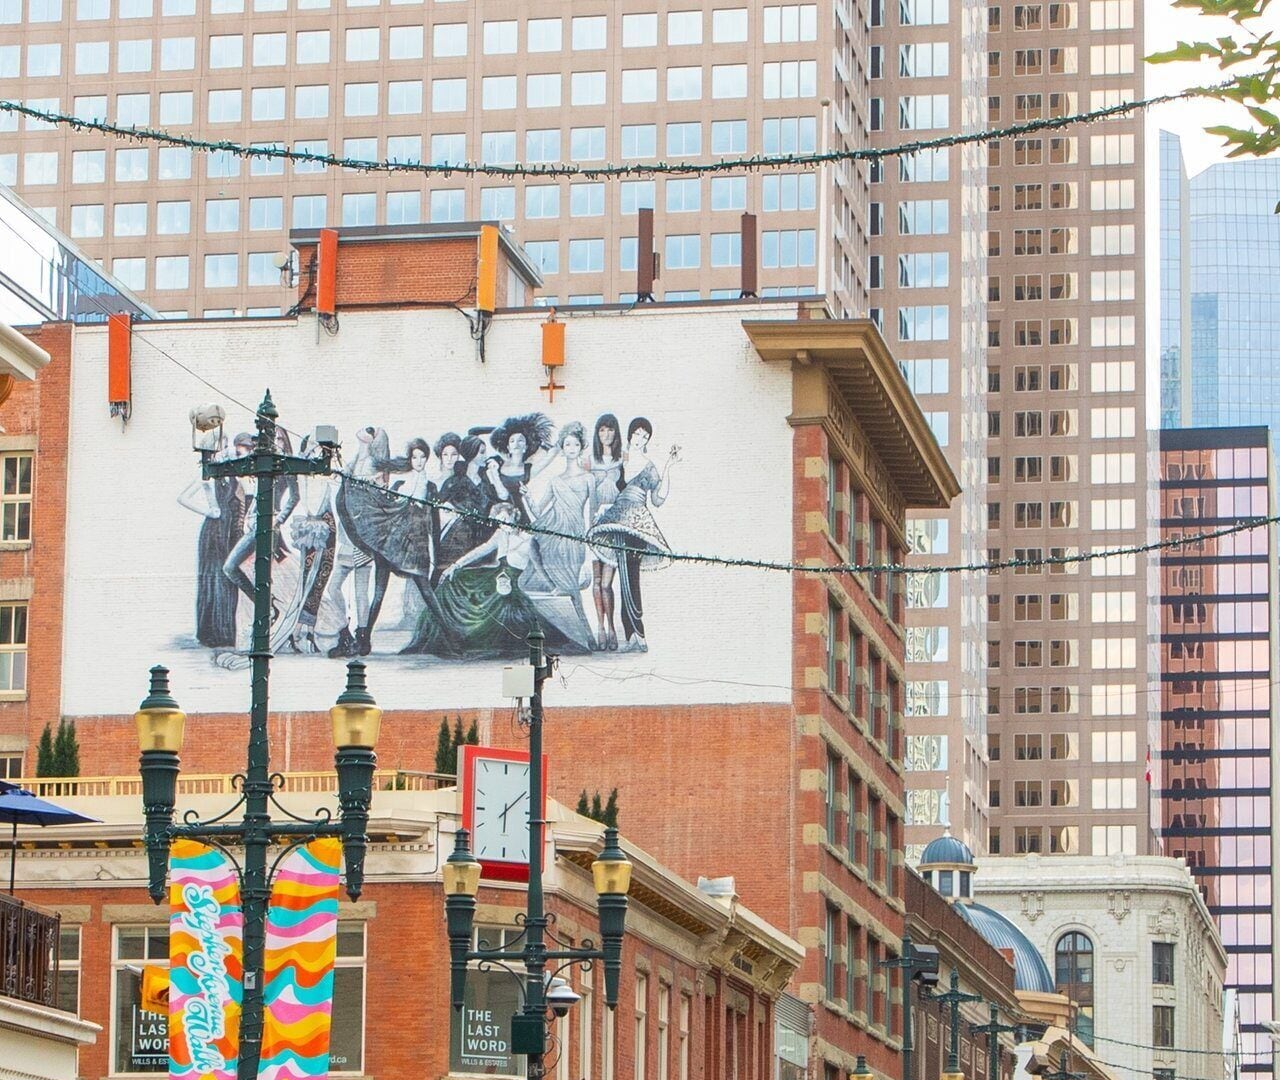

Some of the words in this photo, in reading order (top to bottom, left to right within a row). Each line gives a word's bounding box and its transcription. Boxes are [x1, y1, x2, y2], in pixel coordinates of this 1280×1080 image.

[183, 886, 231, 977] Stephen
[189, 953, 227, 1037] Avenue
[139, 1010, 166, 1021] THE
[468, 1009, 492, 1022] THE
[139, 1023, 169, 1036] LAS
[184, 1001, 224, 1071] Walk
[468, 1025, 500, 1037] LAST
[139, 1038, 170, 1051] WOR
[467, 1039, 507, 1052] WORD
[461, 1058, 478, 1066] WILLS
[484, 1059, 508, 1067] ESTATES
